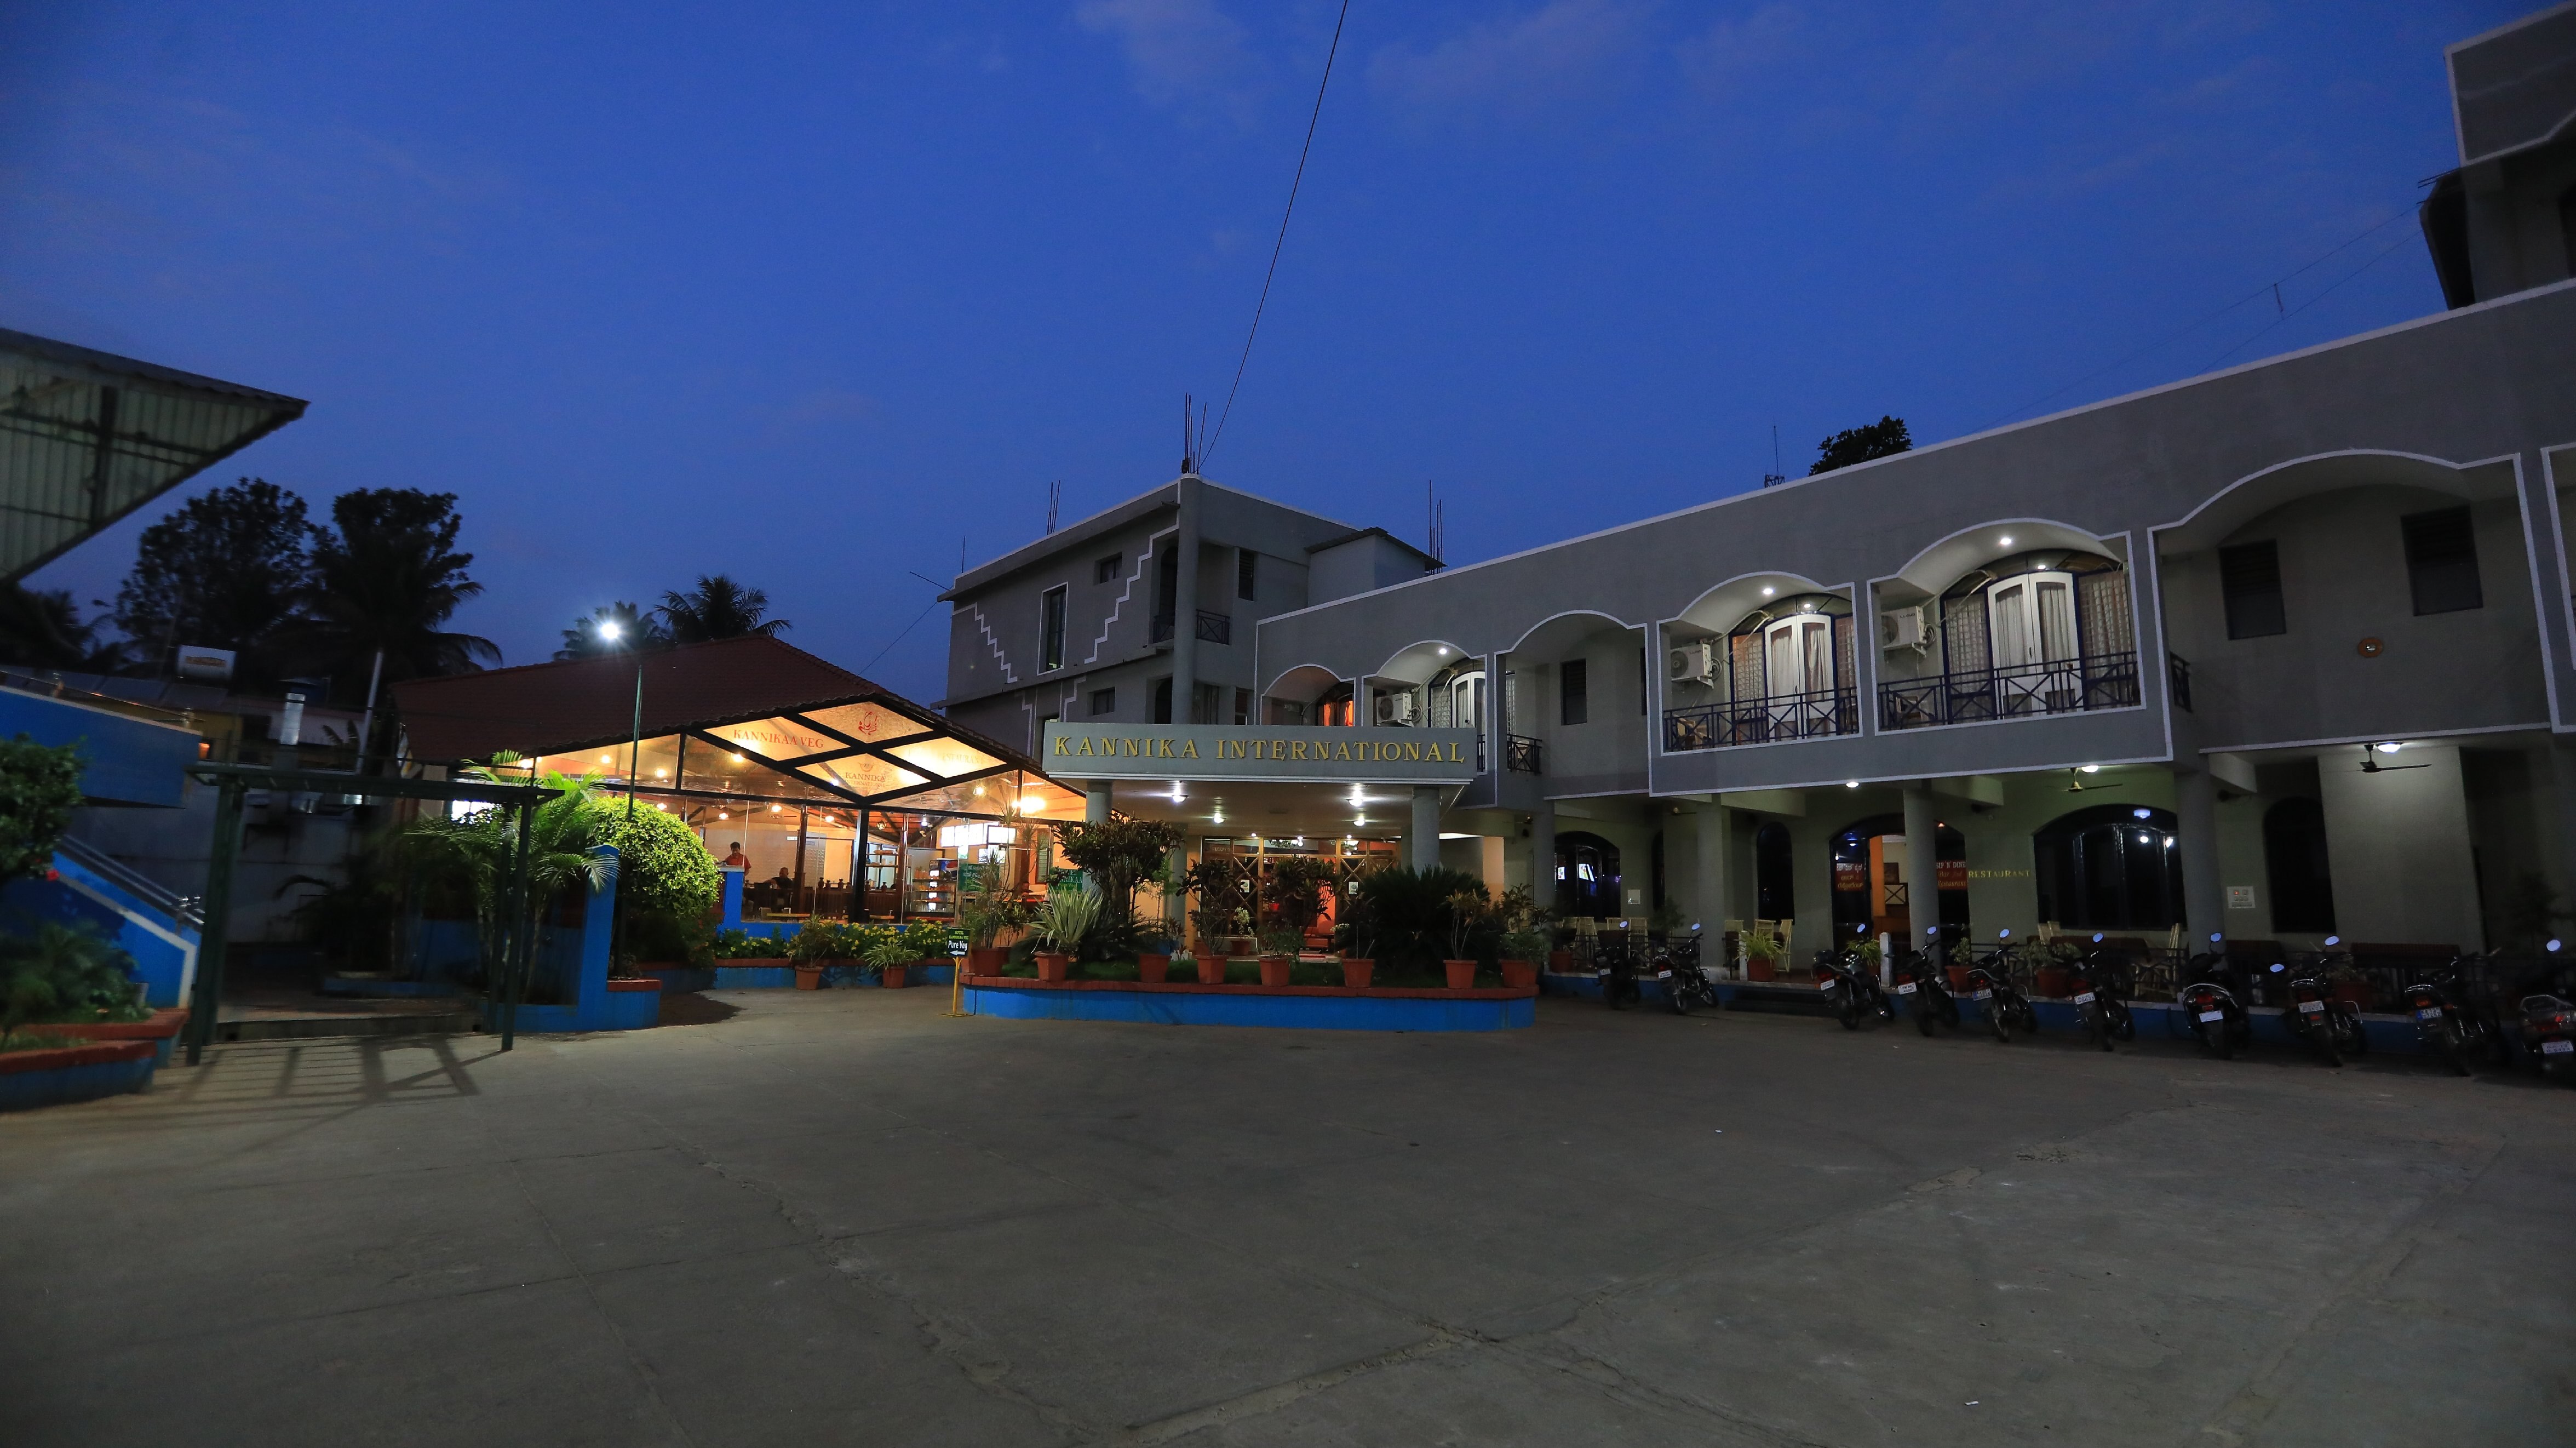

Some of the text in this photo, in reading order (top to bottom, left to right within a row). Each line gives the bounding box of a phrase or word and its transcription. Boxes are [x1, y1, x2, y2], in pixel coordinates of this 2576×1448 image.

[733, 729, 824, 748] KANNIKAA VEG
[1054, 736, 1466, 763] KANNIKA INTERNATIONAL
[941, 753, 984, 765] ESTAURANT
[845, 772, 886, 782] KANNIKA
[948, 940, 968, 951] Pure Veg
